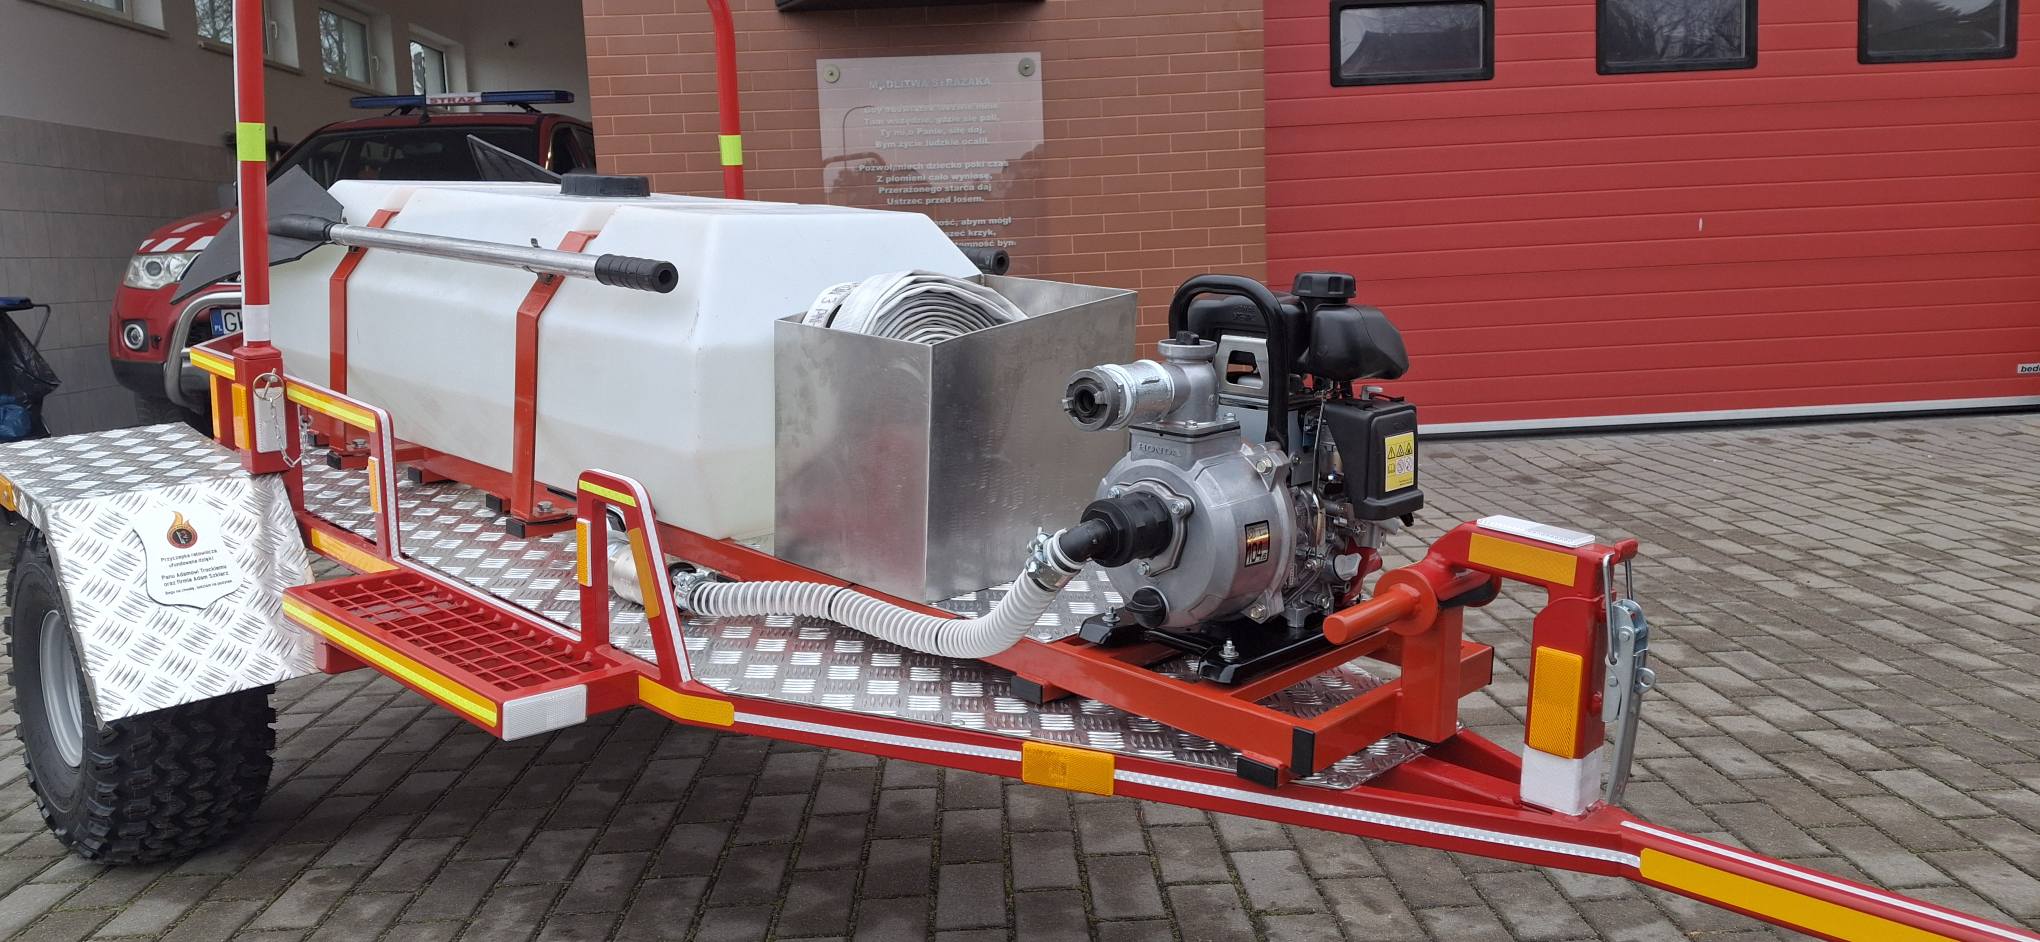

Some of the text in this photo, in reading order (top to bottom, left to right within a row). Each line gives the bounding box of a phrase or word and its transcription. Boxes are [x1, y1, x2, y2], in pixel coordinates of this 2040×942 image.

[876, 175, 884, 183] Z
[944, 184, 975, 192] starca
[977, 183, 992, 192] daj
[887, 197, 923, 206] Ustrzec
[925, 196, 951, 206] przed
[961, 217, 986, 227] abym
[2021, 365, 2040, 373] bed
